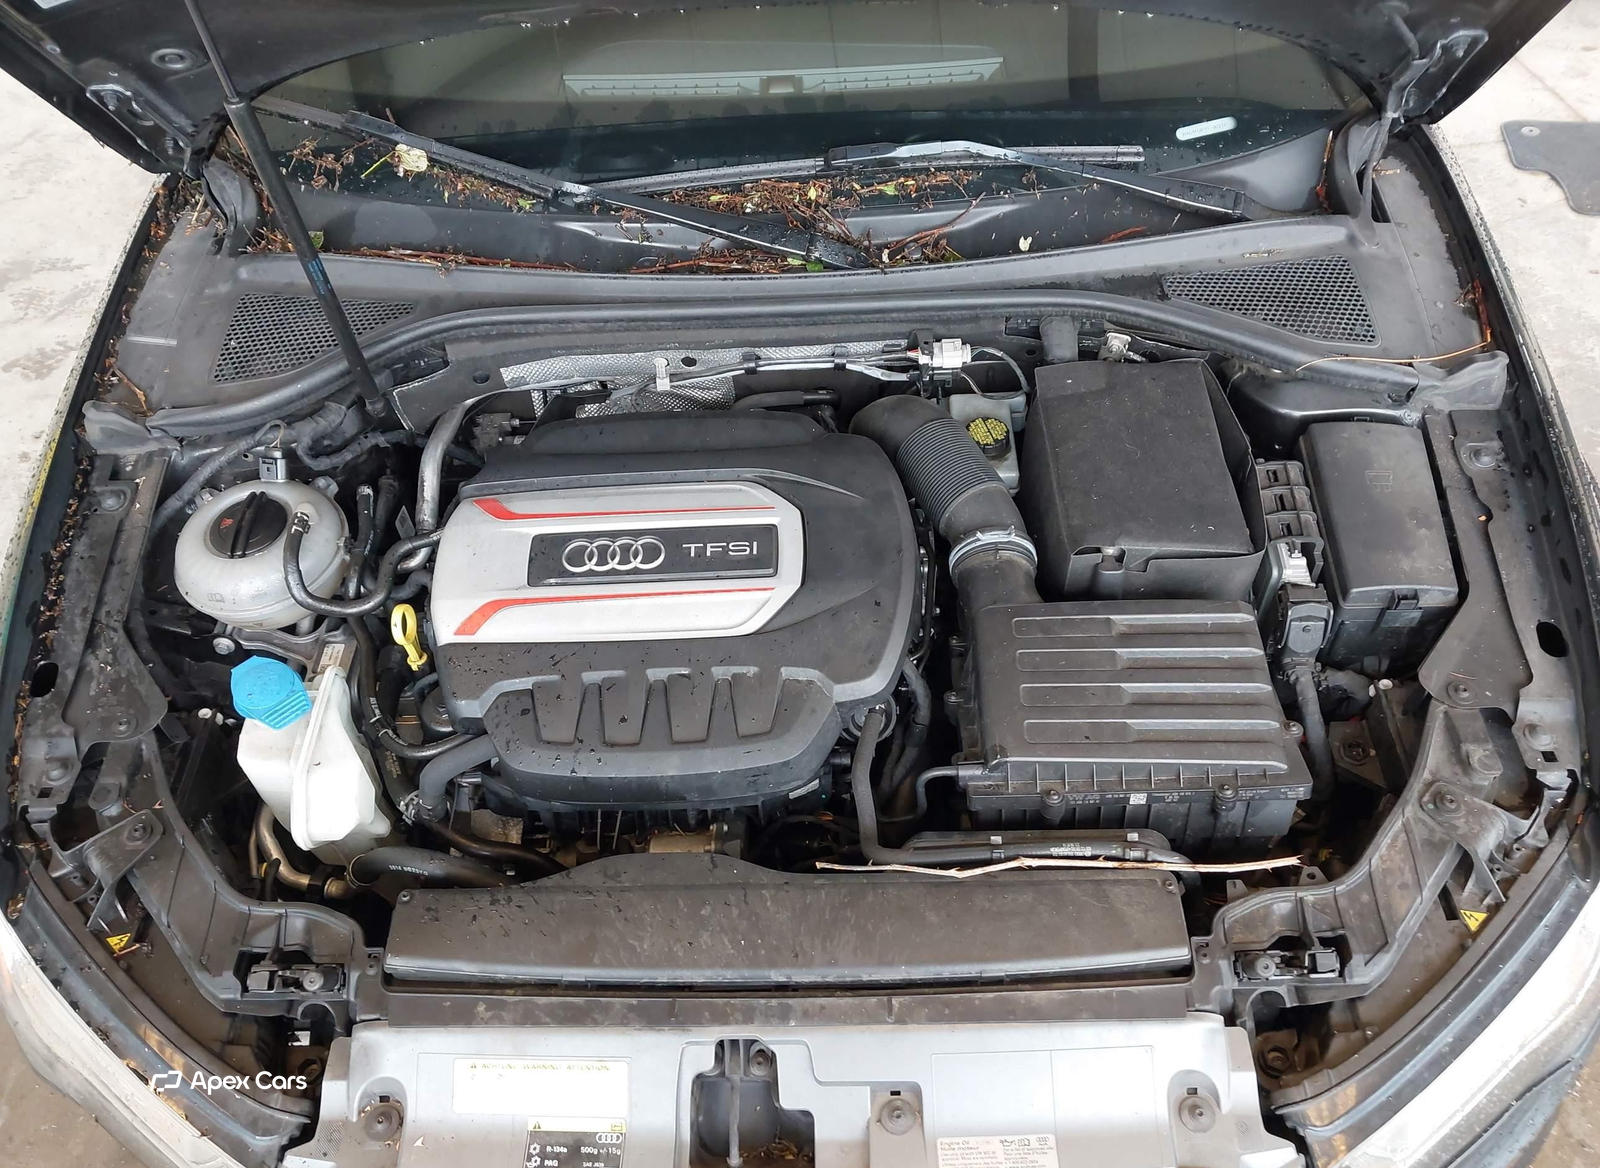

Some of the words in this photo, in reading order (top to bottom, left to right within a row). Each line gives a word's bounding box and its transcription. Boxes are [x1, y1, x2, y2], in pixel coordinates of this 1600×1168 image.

[682, 541, 757, 557] TFSI
[546, 1145, 568, 1153] R-134a
[580, 1146, 598, 1155] 500g
[544, 1159, 559, 1167] PAG
